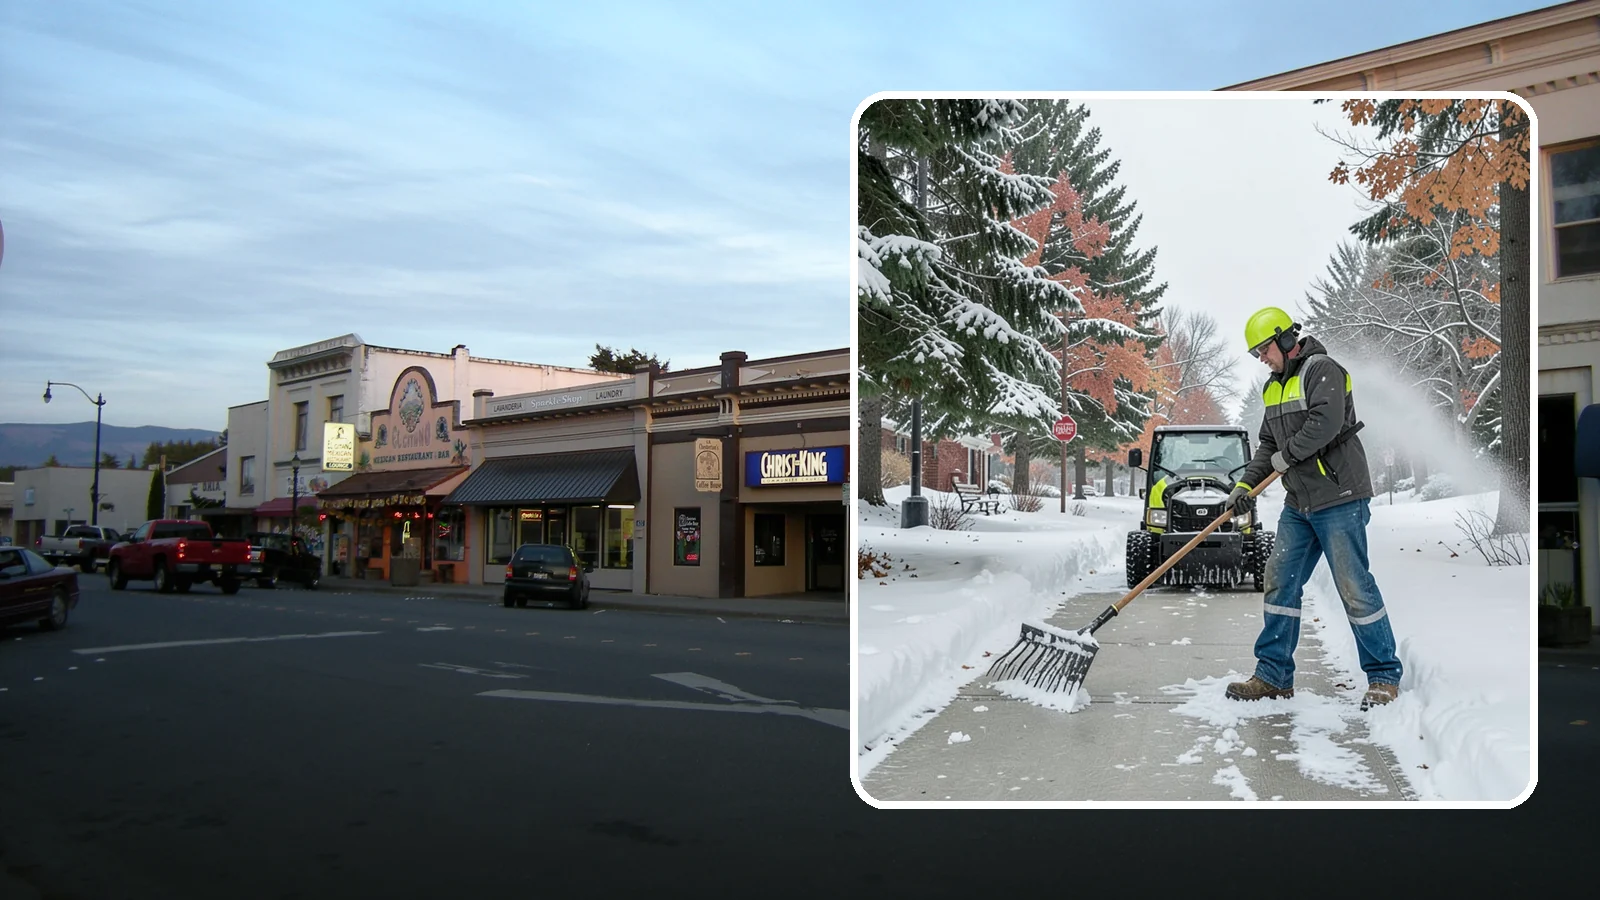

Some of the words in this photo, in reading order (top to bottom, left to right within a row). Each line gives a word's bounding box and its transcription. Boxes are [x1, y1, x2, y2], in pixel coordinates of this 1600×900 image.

[562, 394, 582, 404] Shop
[596, 389, 623, 400] LAUNDRY
[493, 402, 523, 413] LAVANDERIA
[397, 451, 434, 462] RESTAURANT
[437, 450, 450, 459] BAR
[760, 452, 797, 478] CHRIST
[799, 450, 827, 476] KING
